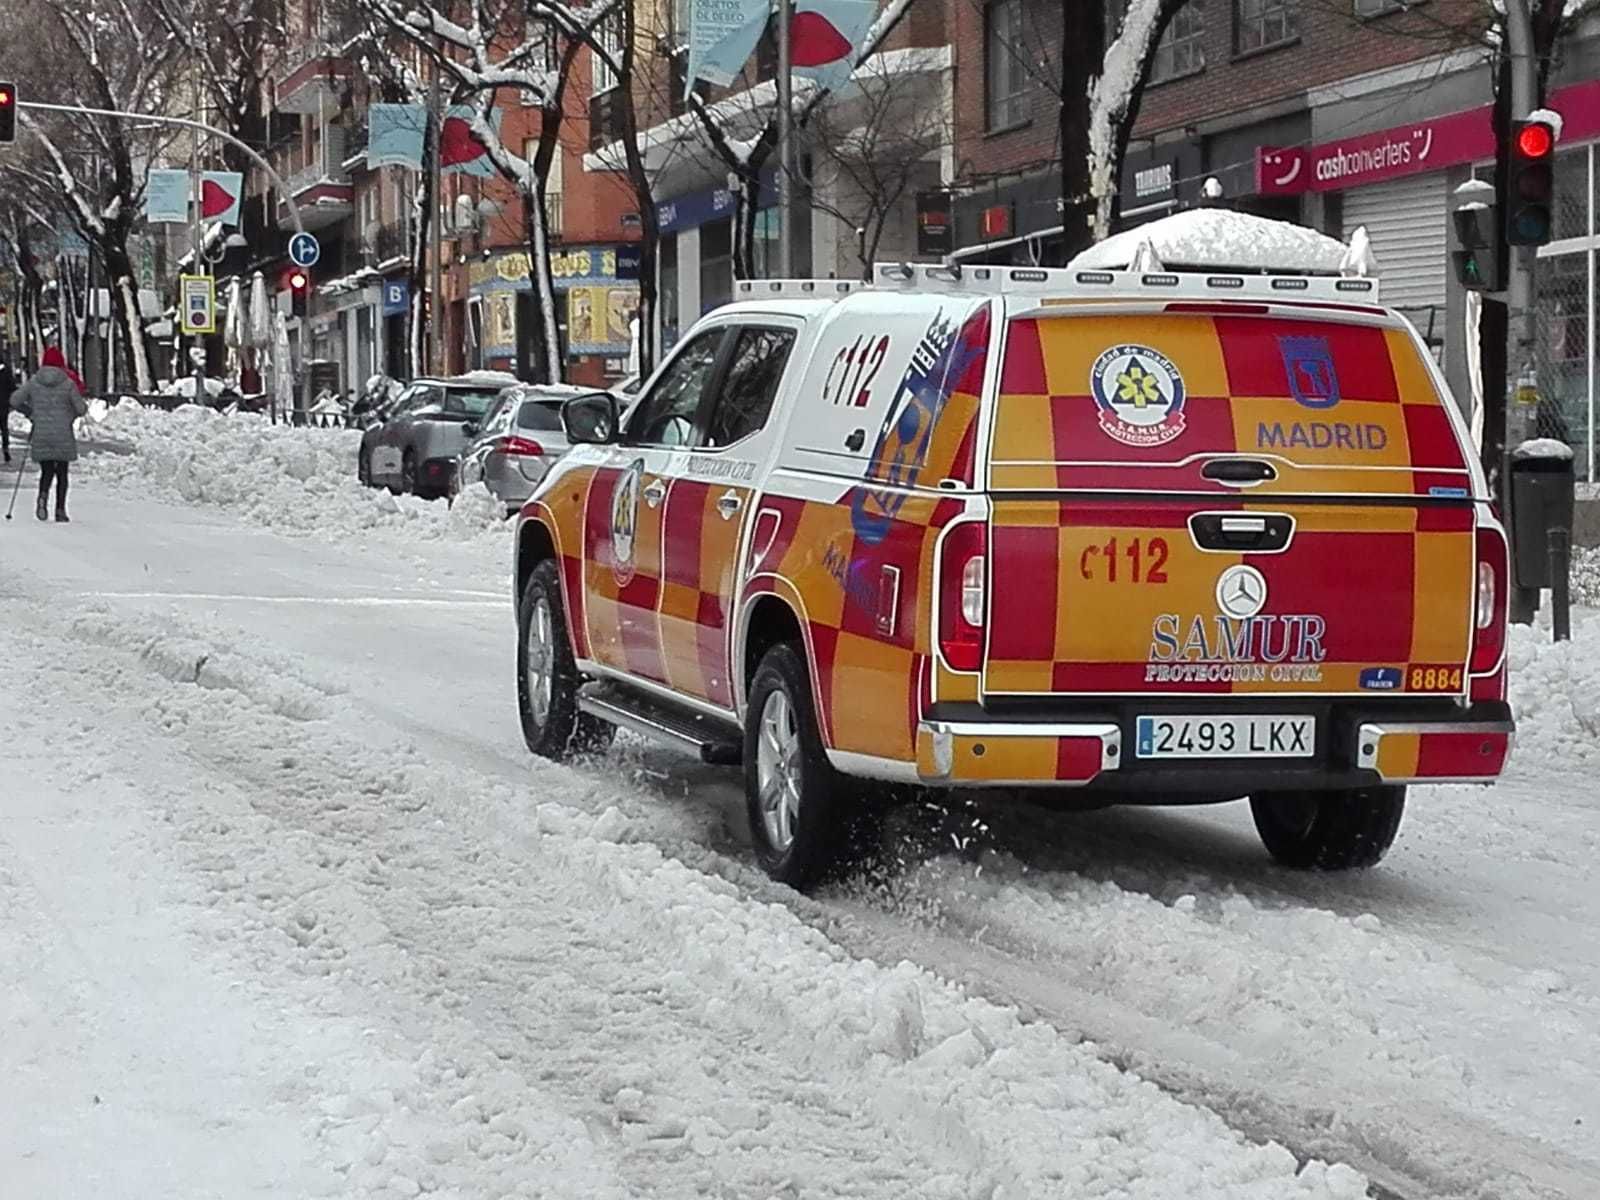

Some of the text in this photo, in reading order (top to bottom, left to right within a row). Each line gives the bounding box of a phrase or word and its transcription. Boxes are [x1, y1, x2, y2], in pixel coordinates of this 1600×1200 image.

[1316, 140, 1411, 180] cashconverters
[834, 334, 890, 408] 112
[1095, 346, 1180, 380] ciudad de madrid
[1257, 422, 1387, 450] MADRID
[1103, 537, 1168, 584] 112
[1149, 613, 1327, 663] SAMUR
[1144, 663, 1322, 682] PROTECCION CIVIL
[1411, 668, 1461, 689] 8884
[1156, 721, 1307, 753] 2493 LKX
